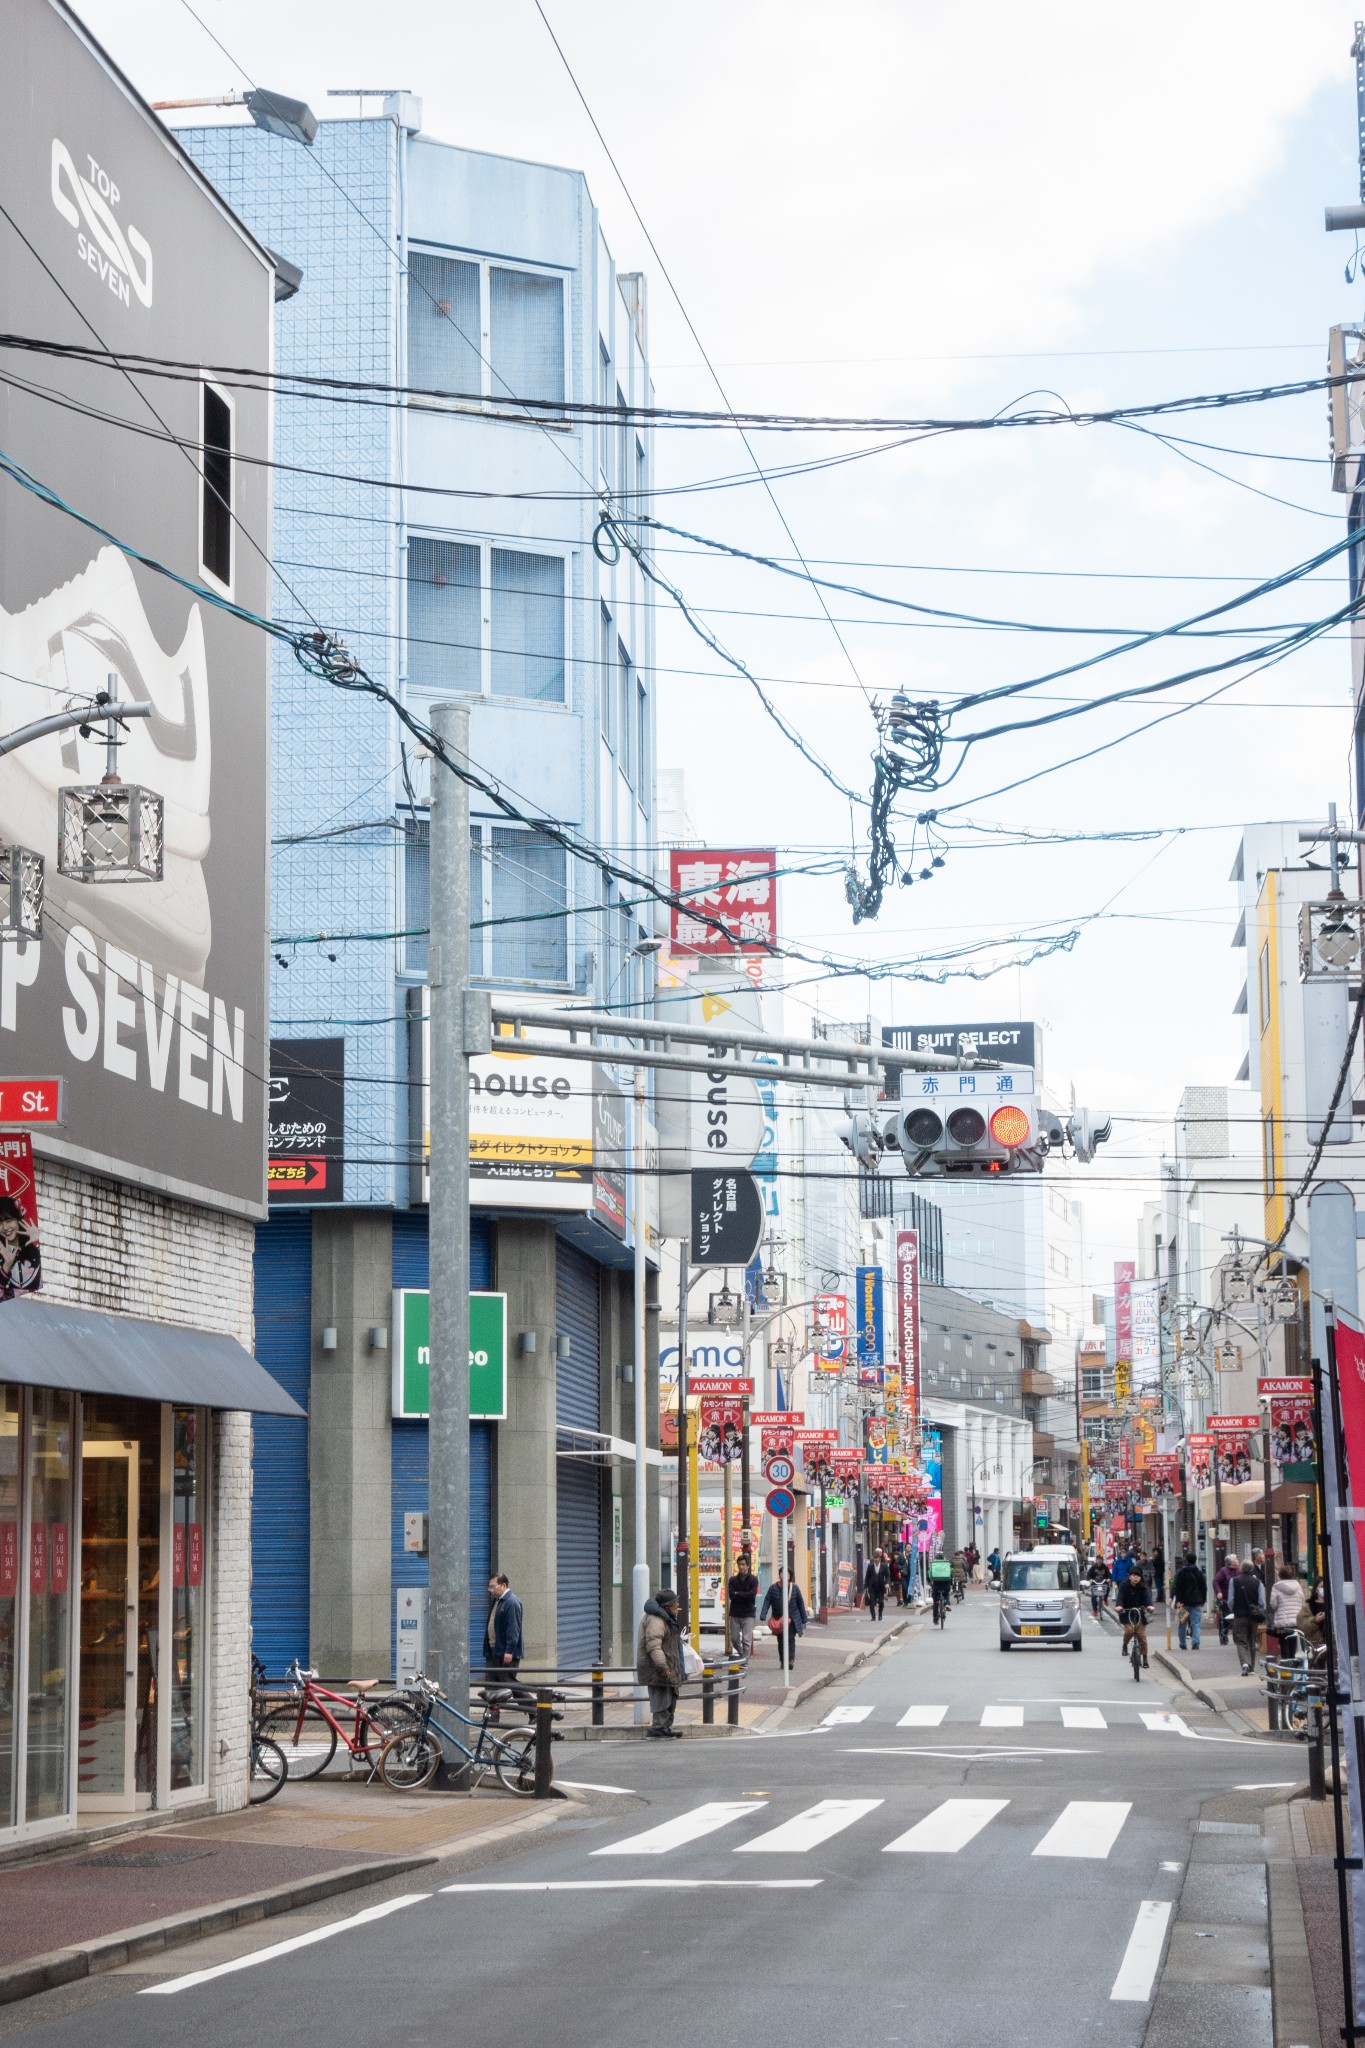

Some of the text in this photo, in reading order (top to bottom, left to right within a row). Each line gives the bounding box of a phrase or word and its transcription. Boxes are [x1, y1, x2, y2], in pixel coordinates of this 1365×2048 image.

[87, 153, 121, 206] TOP
[77, 232, 130, 308] SEVEN
[677, 861, 770, 907] 東海
[62, 925, 245, 1123] SEVEN
[917, 1030, 1021, 1048] SUIT SELECT
[22, 1091, 49, 1112] St.
[708, 1047, 728, 1149] ouse
[921, 1075, 1014, 1094] 赤門通
[713, 1178, 723, 1234] ダイレクト
[726, 1178, 737, 1212] 名古屋
[699, 1212, 710, 1256] ショップ
[902, 1264, 913, 1301] COMIC
[1118, 1269, 1132, 1355] タカラ屋
[693, 1382, 732, 1391] AKAMON
[1262, 1382, 1303, 1391] AKAMON
[755, 1415, 787, 1423] AKAMON
[1210, 1418, 1243, 1427] AKAMON
[1281, 1410, 1304, 1420] 赤門
[772, 1465, 788, 1478] 30
